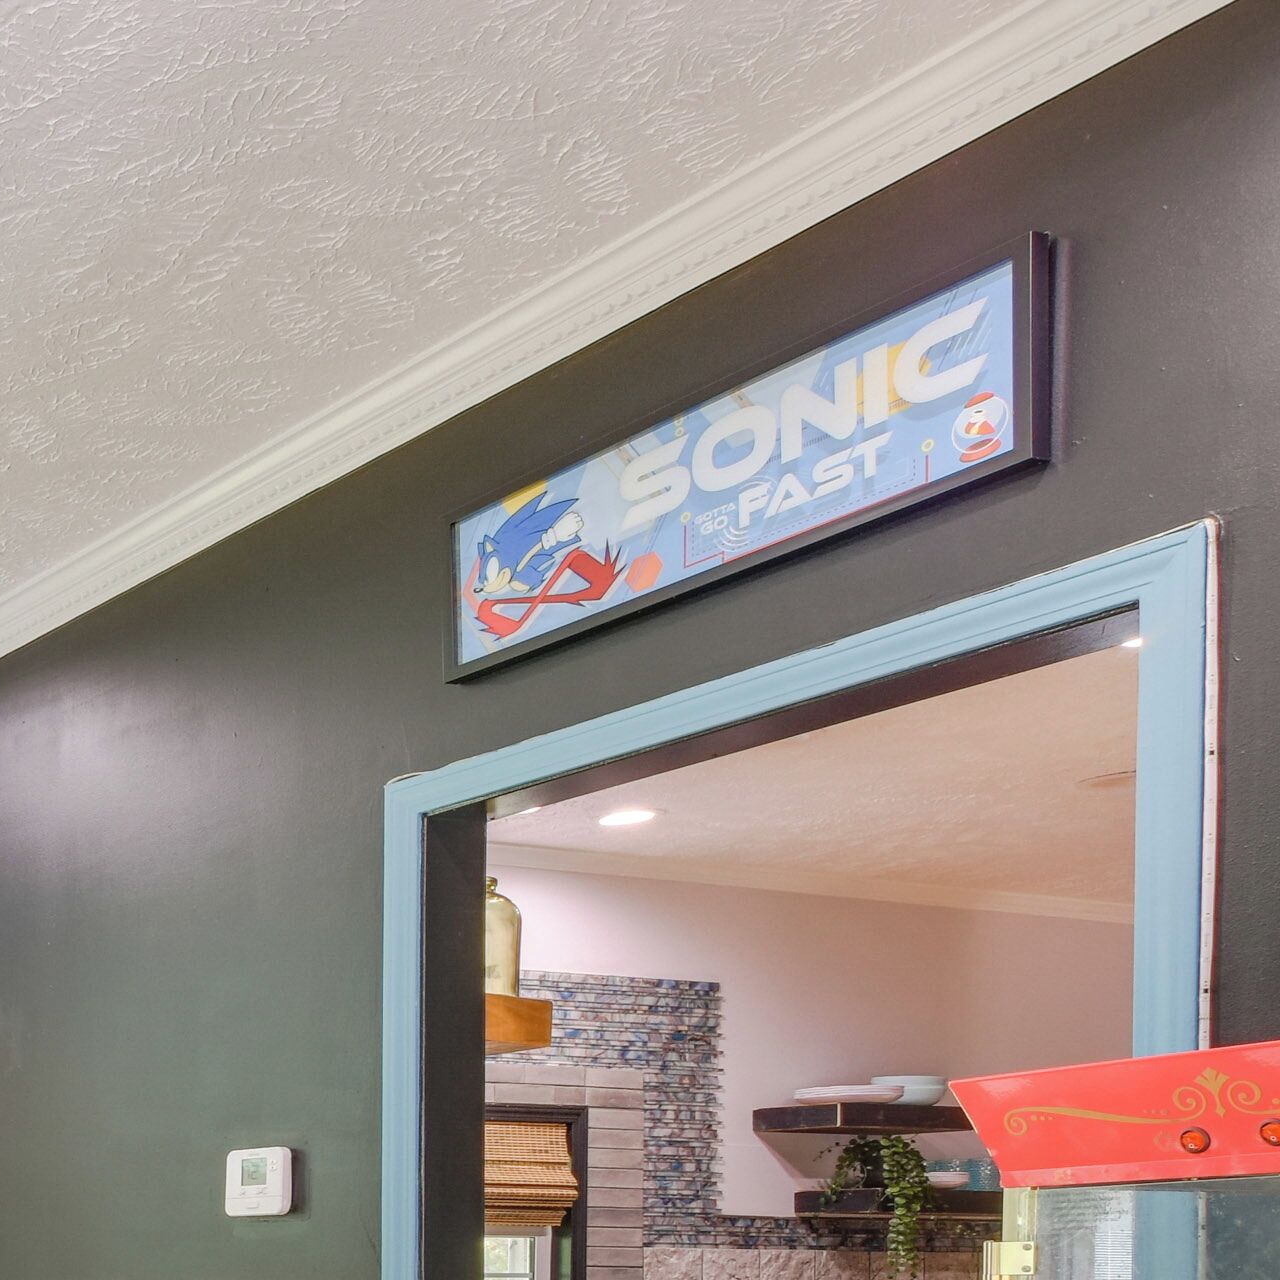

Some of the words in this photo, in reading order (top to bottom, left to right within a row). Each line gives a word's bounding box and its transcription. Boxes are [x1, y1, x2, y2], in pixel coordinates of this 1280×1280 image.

[615, 296, 991, 535] SONIC
[739, 430, 894, 529] FAST
[694, 502, 737, 525] GOTTA
[700, 515, 729, 536] GO
